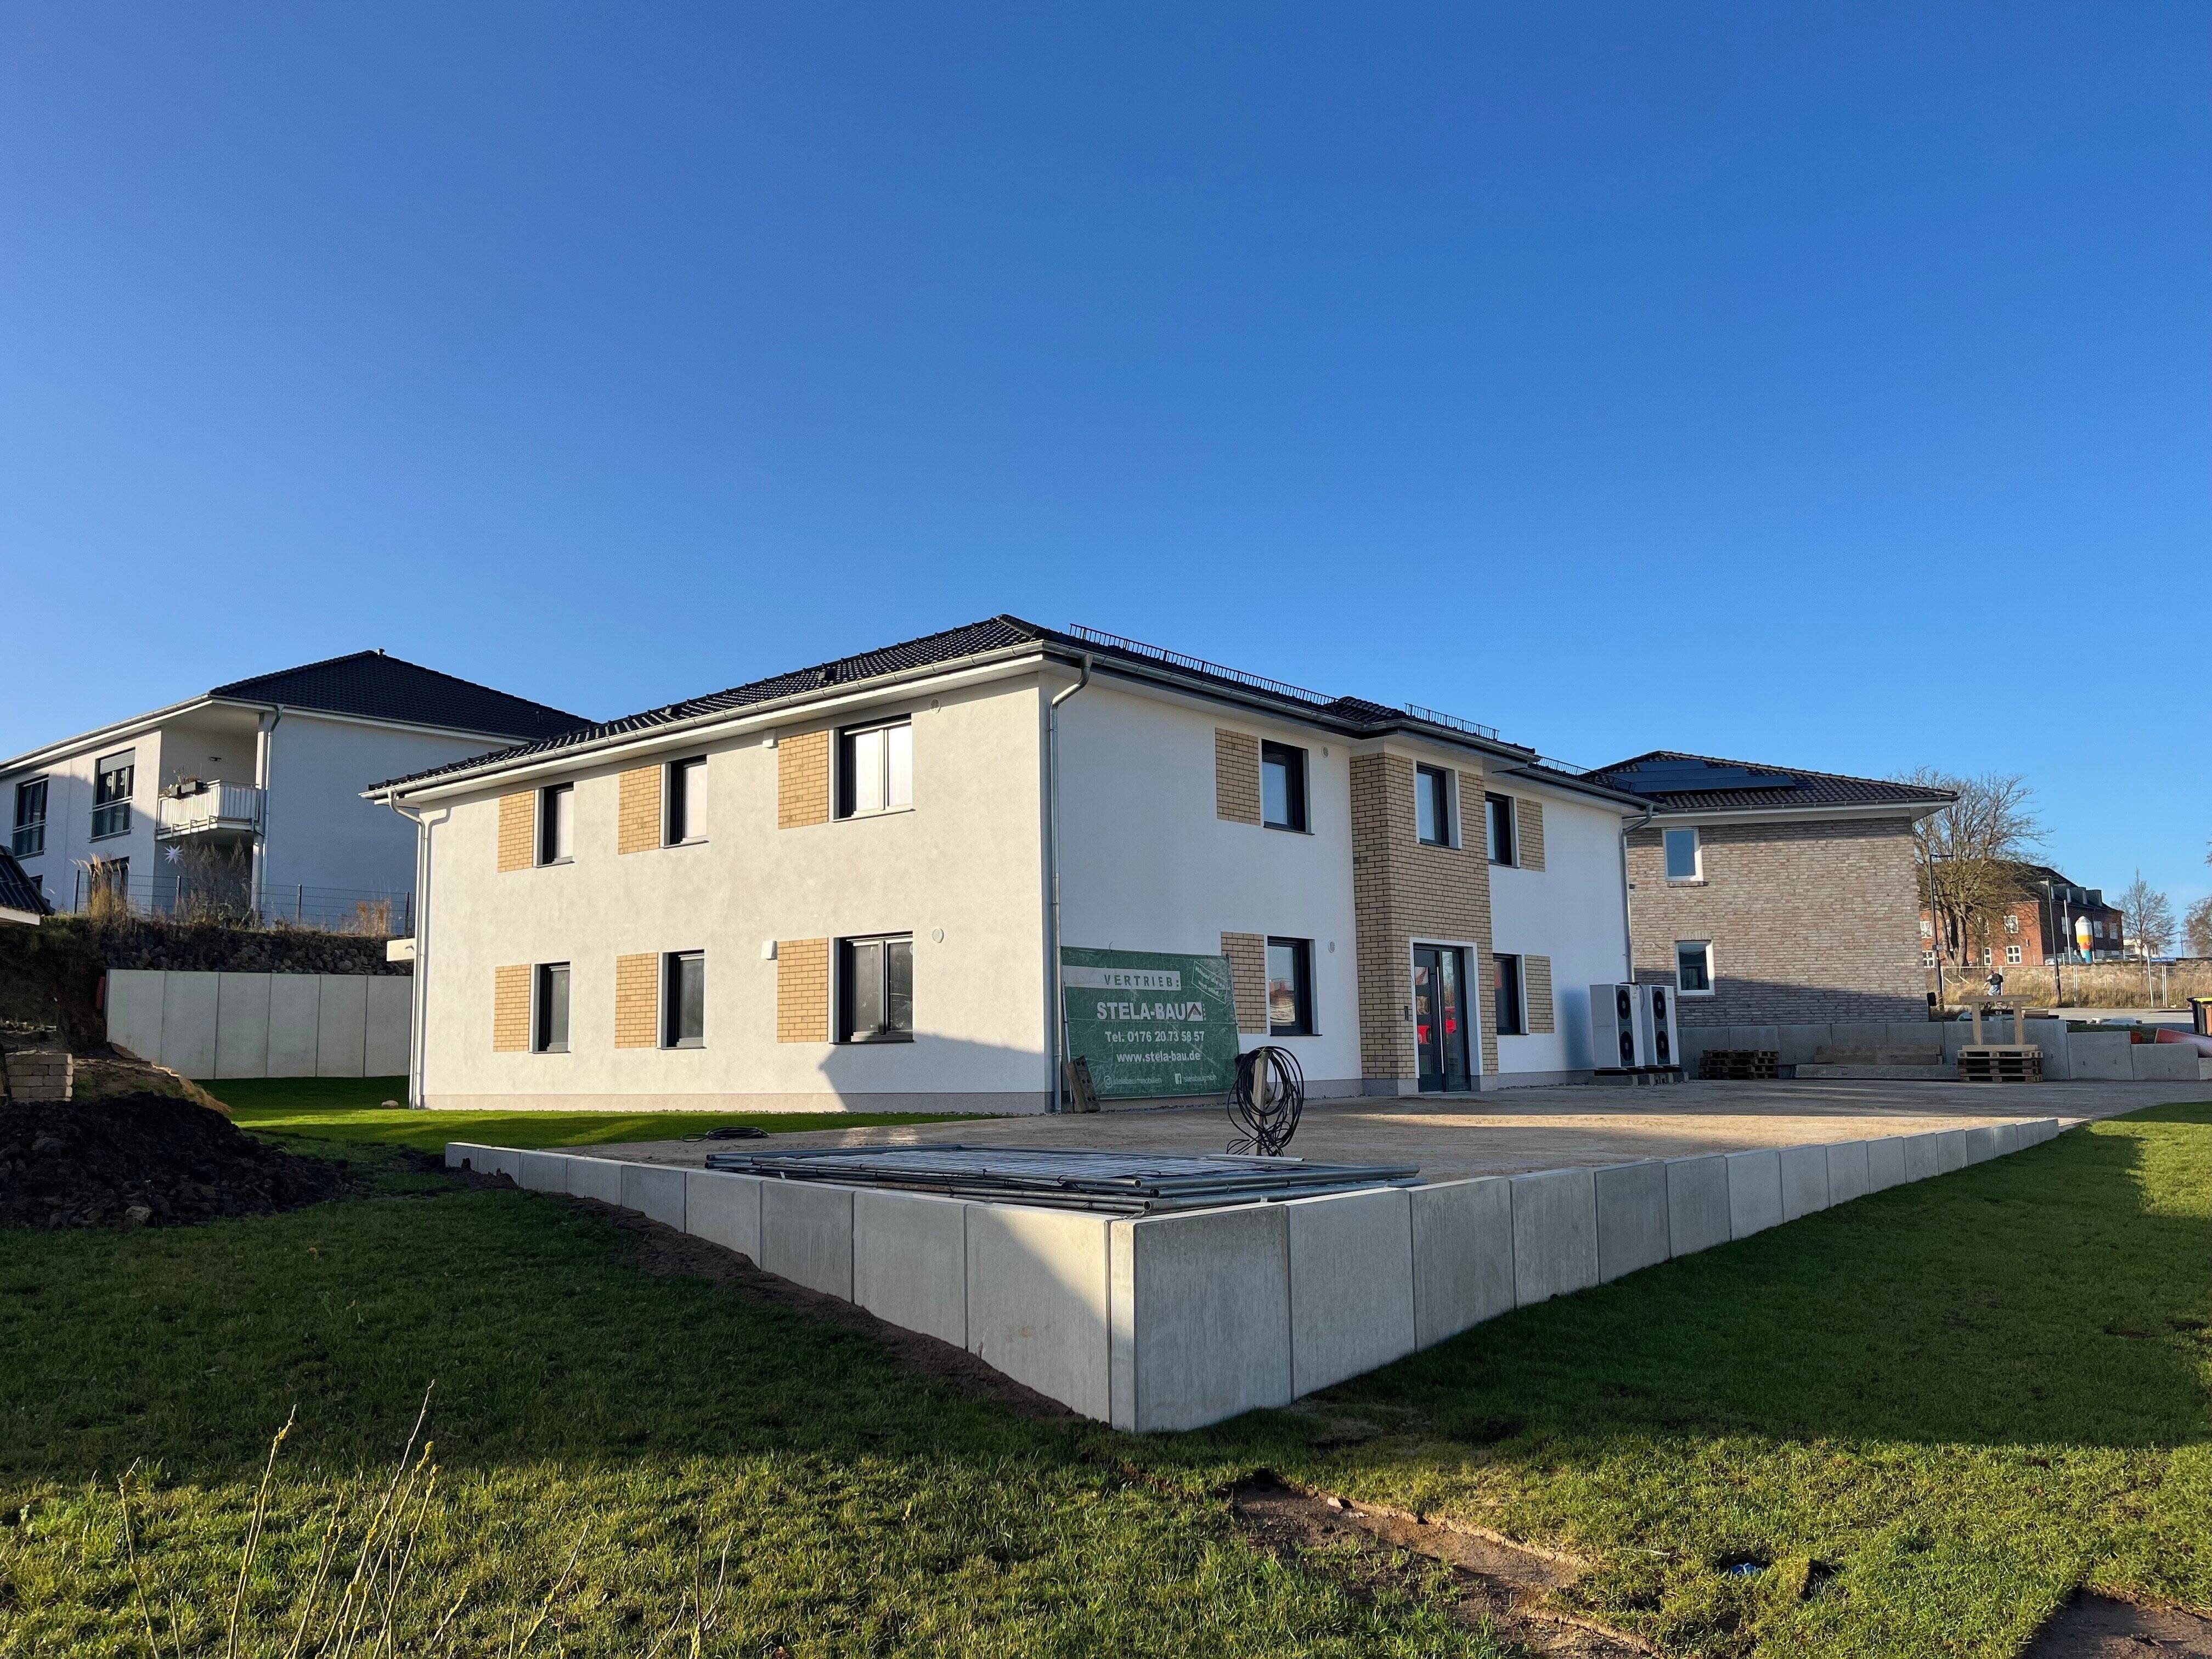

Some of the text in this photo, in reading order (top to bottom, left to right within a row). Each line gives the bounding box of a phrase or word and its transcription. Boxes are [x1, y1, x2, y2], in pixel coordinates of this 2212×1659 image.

[1104, 974, 1180, 987] VERTRIEB:
[1097, 1002, 1186, 1020] STELA-BAU
[1105, 1031, 1205, 1042] Tel. 0176 20 73 58 57
[1116, 1050, 1201, 1063] www.stela-bau.de
